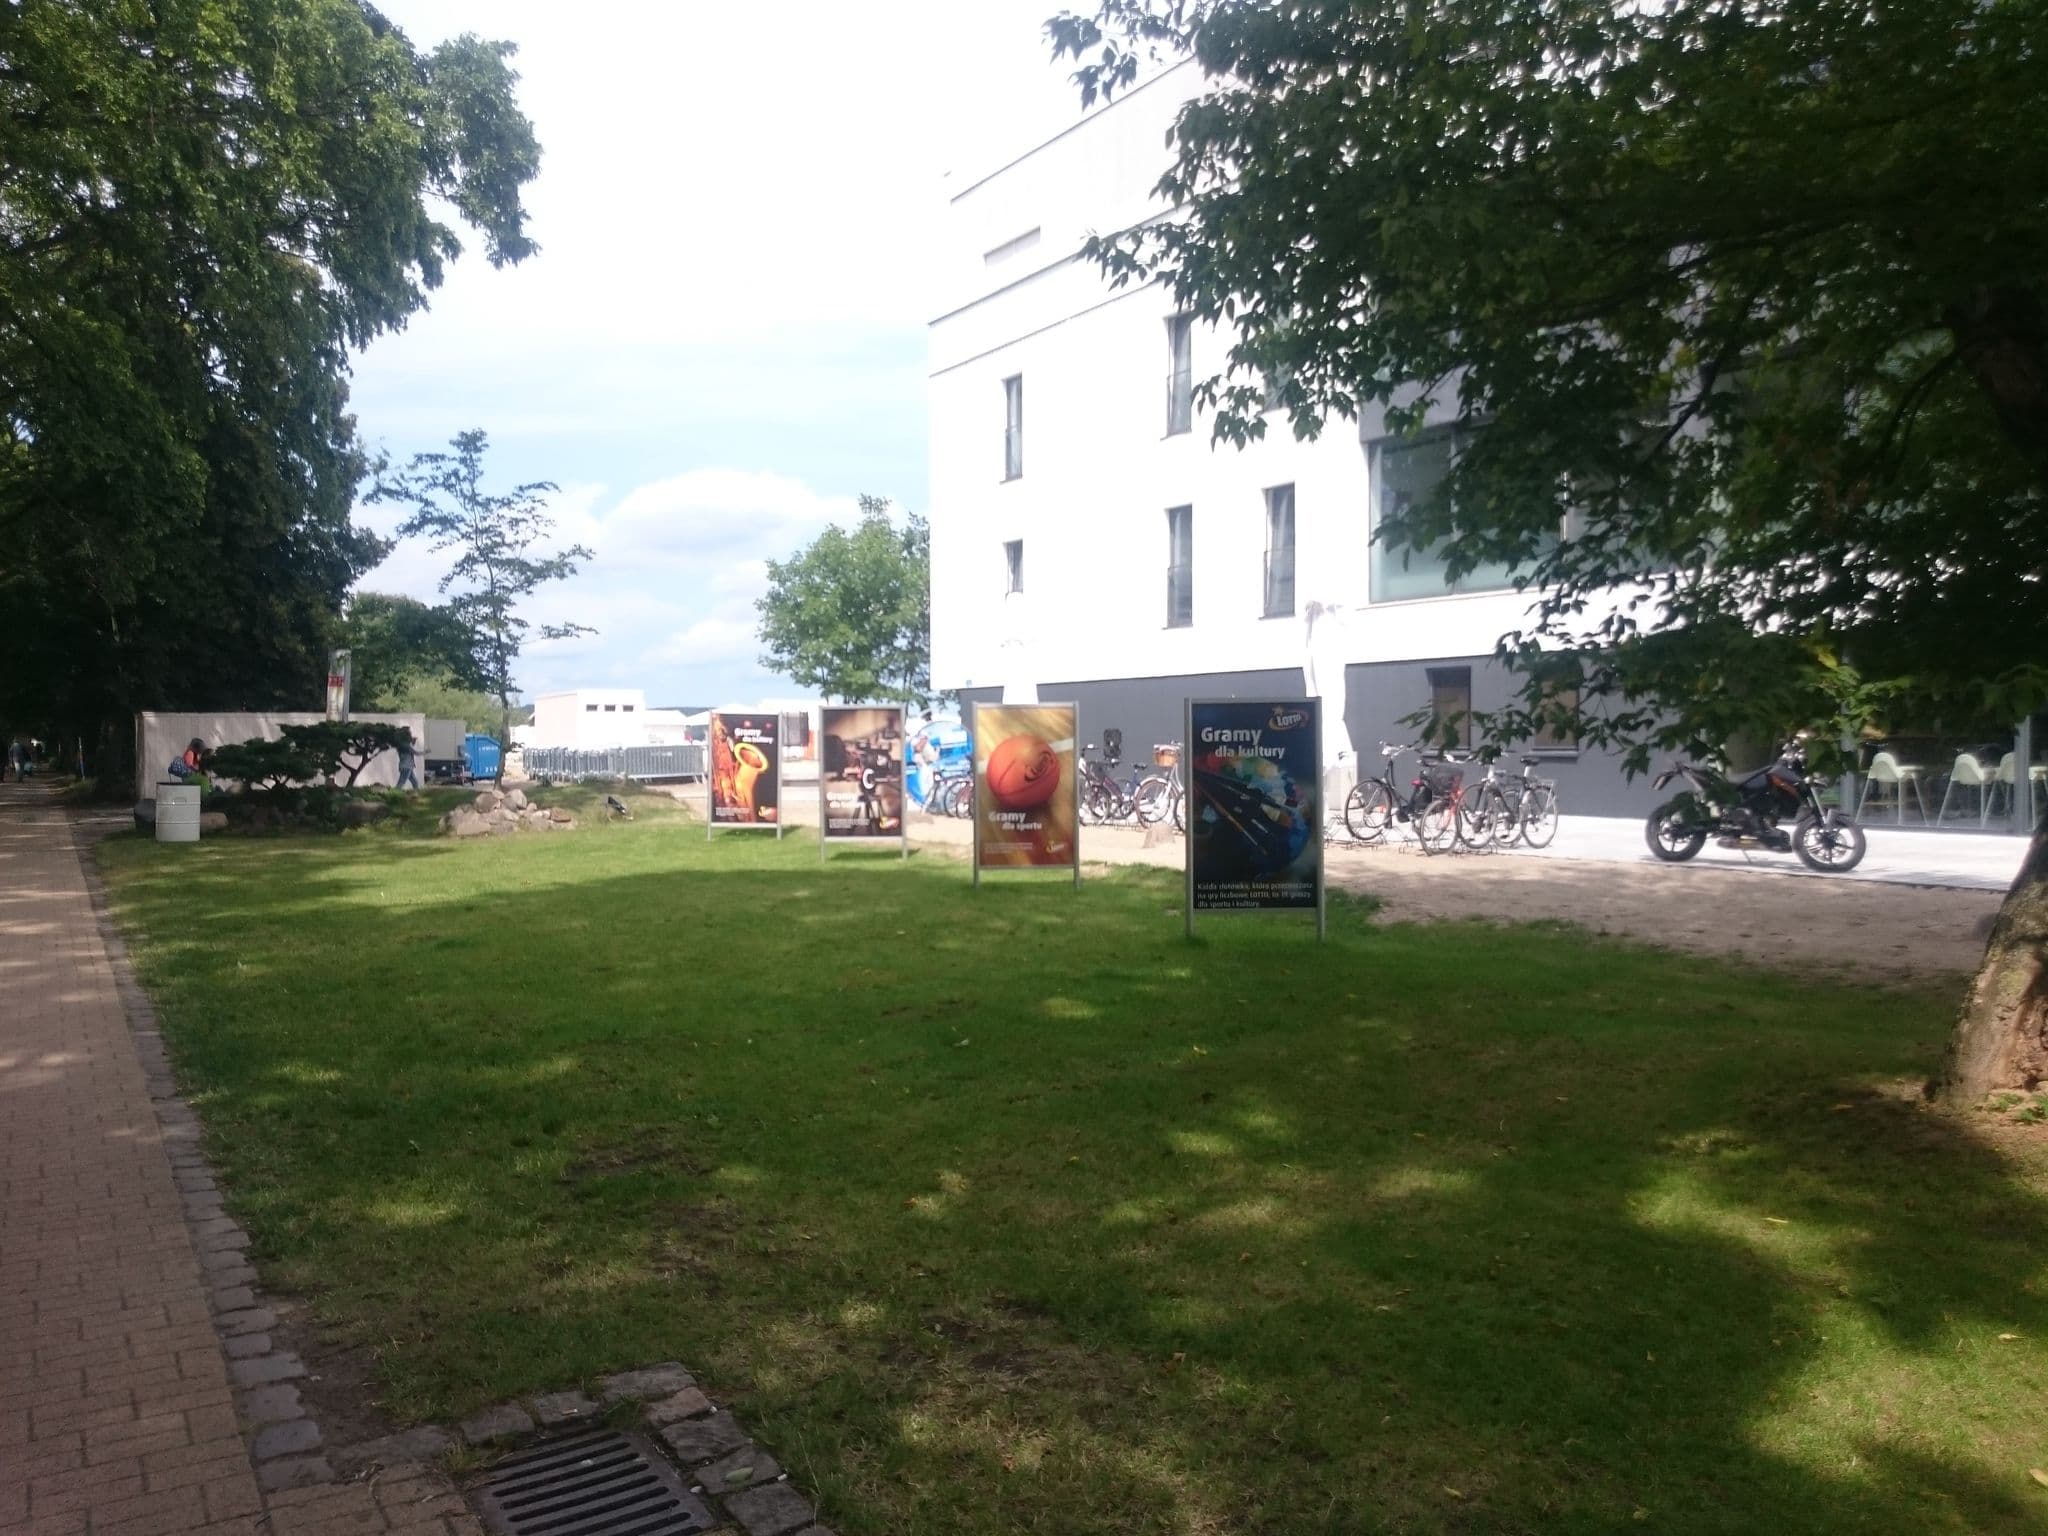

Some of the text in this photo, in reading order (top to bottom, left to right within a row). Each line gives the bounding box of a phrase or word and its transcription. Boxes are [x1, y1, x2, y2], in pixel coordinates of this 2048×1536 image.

[1201, 727, 1262, 745] Gramy
[1215, 745, 1285, 759] dla kultury
[988, 811, 1026, 823] Gramy
[1016, 822, 1042, 832] sportu
